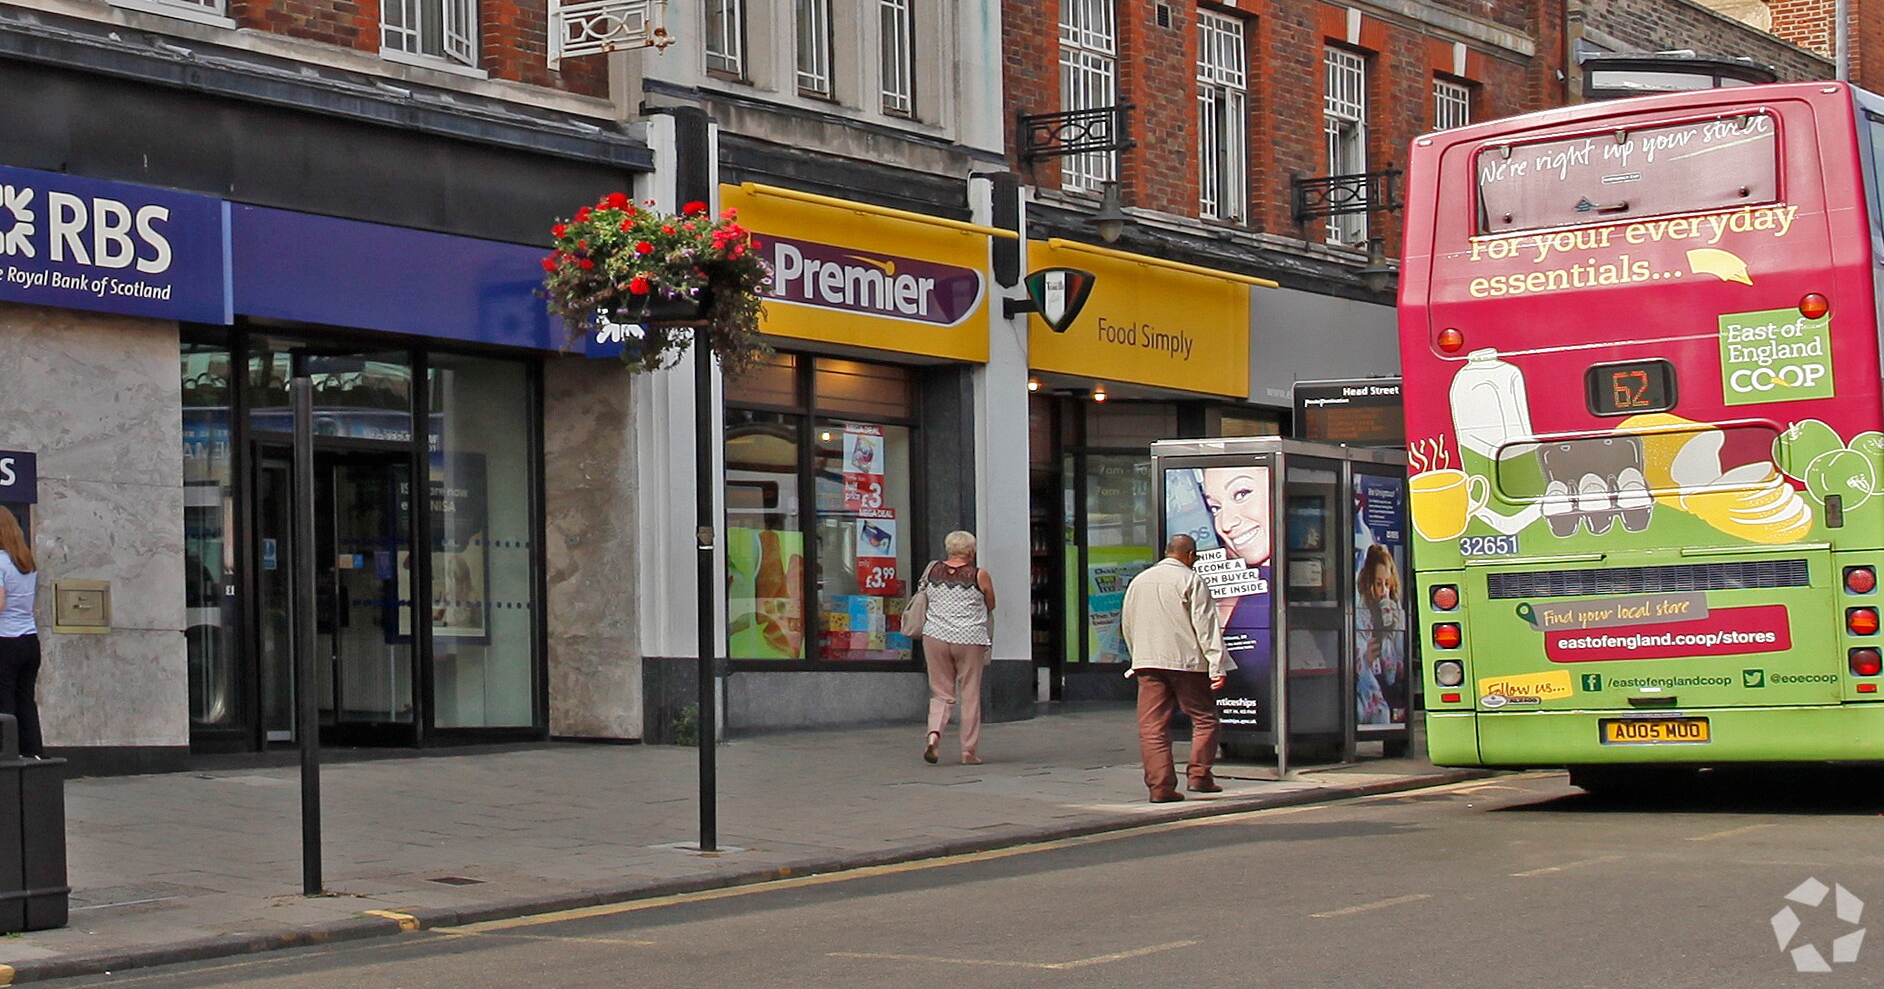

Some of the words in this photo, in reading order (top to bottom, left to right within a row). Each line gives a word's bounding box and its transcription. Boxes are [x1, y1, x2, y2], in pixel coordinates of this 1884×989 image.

[1535, 139, 1595, 180] right
[1603, 141, 1633, 167] up
[1642, 129, 1696, 162] your
[1703, 115, 1769, 143] street
[48, 190, 172, 274] RBS
[1469, 236, 1523, 262] For
[1532, 226, 1616, 263] your
[1625, 204, 1799, 245] everyday
[7, 266, 48, 289] Royal
[51, 271, 88, 291] Bank
[91, 276, 109, 298] of
[110, 278, 172, 301] Scotland
[774, 242, 935, 316] Premier
[1469, 255, 1683, 298] essentials...
[1098, 316, 1137, 346] Food
[1141, 323, 1194, 361] Simply
[1727, 324, 1778, 344] East
[1780, 317, 1806, 338] of
[1727, 336, 1824, 366] England
[1342, 386, 1369, 396] Head
[1370, 385, 1400, 395] Street
[1612, 370, 1651, 408] 62
[0, 457, 16, 486] S
[861, 482, 882, 508] £3
[1459, 535, 1518, 556] 32651
[865, 566, 895, 589] £3.99
[1221, 571, 1258, 583] BUYER
[1234, 560, 1243, 569] A
[1230, 583, 1263, 594] INSIDE
[1543, 607, 1574, 627] Find
[1578, 608, 1614, 630] your
[1616, 600, 1651, 619] local
[1656, 598, 1691, 616] store
[1557, 630, 1777, 651] eastofengland.coop/stores
[1487, 681, 1530, 696] Follow
[1607, 675, 1733, 689] /eastofenglandcoop
[1770, 673, 1839, 685] @eoecoop
[1616, 724, 1660, 739] AU05
